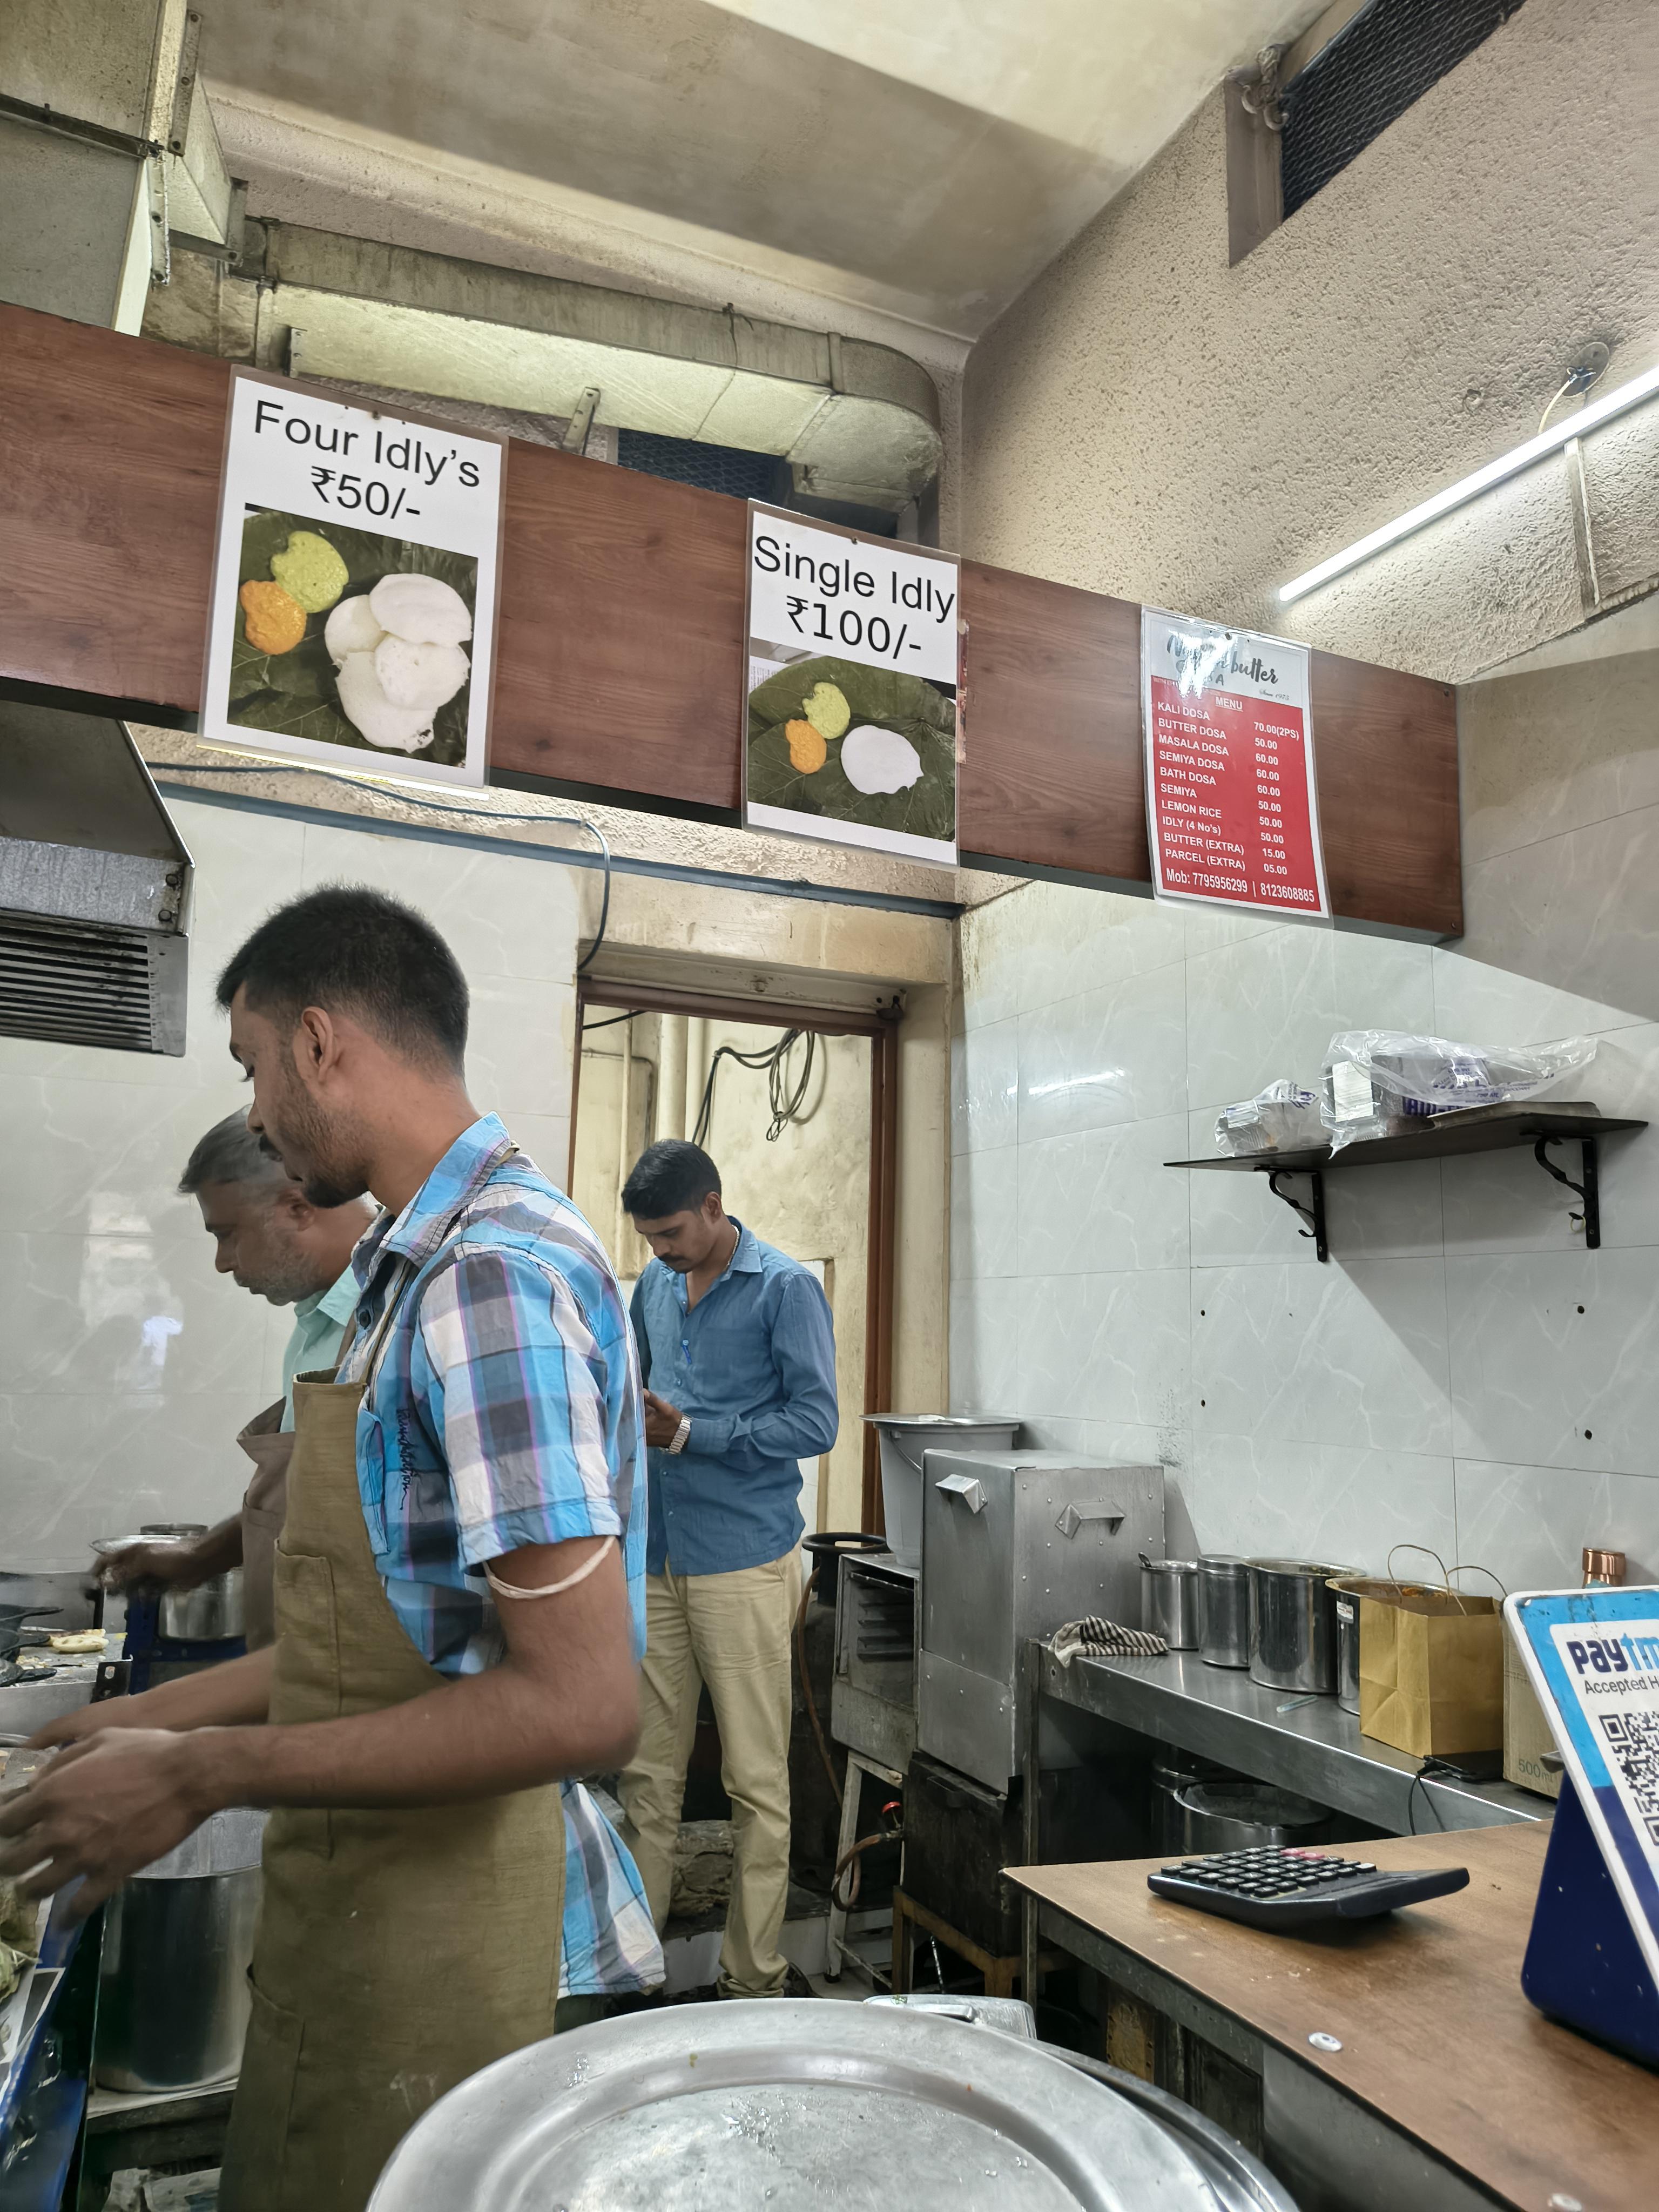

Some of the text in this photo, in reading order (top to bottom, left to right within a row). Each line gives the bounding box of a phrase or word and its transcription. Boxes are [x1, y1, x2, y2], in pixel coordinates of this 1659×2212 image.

[255, 400, 480, 487] Four Idly's
[311, 466, 421, 519] ₹50/-
[754, 536, 954, 623] Single Idly
[787, 596, 921, 659] ₹100/-
[1231, 651, 1278, 684] butter
[1215, 696, 1243, 710] MENU
[1158, 702, 1299, 741] KALI DOSA 70.00(2PS)
[1158, 718, 1277, 750] BUTTER DOSA 50.00
[1159, 734, 1278, 765] MASALA DOSA 60.00
[1159, 751, 1279, 781] SEMIYA DOSA 60.00
[1160, 766, 1280, 797] BATH DOSA 60.00
[1161, 783, 1281, 812] SEMIYA 50.00
[1162, 800, 1282, 828] LEMON RICE 50.00
[1162, 816, 1284, 844] IDLY (4 No's) 50.00
[1164, 832, 1285, 859] BUTTER (EXTRA) 15.00
[1165, 848, 1287, 875] PARCEL (EXTRA) 05.00
[1166, 868, 1190, 884] Mob:
[1192, 872, 1247, 893] 7795956299
[1260, 883, 1314, 902] 8123608885
[1584, 1676, 1648, 1695] Accepted
